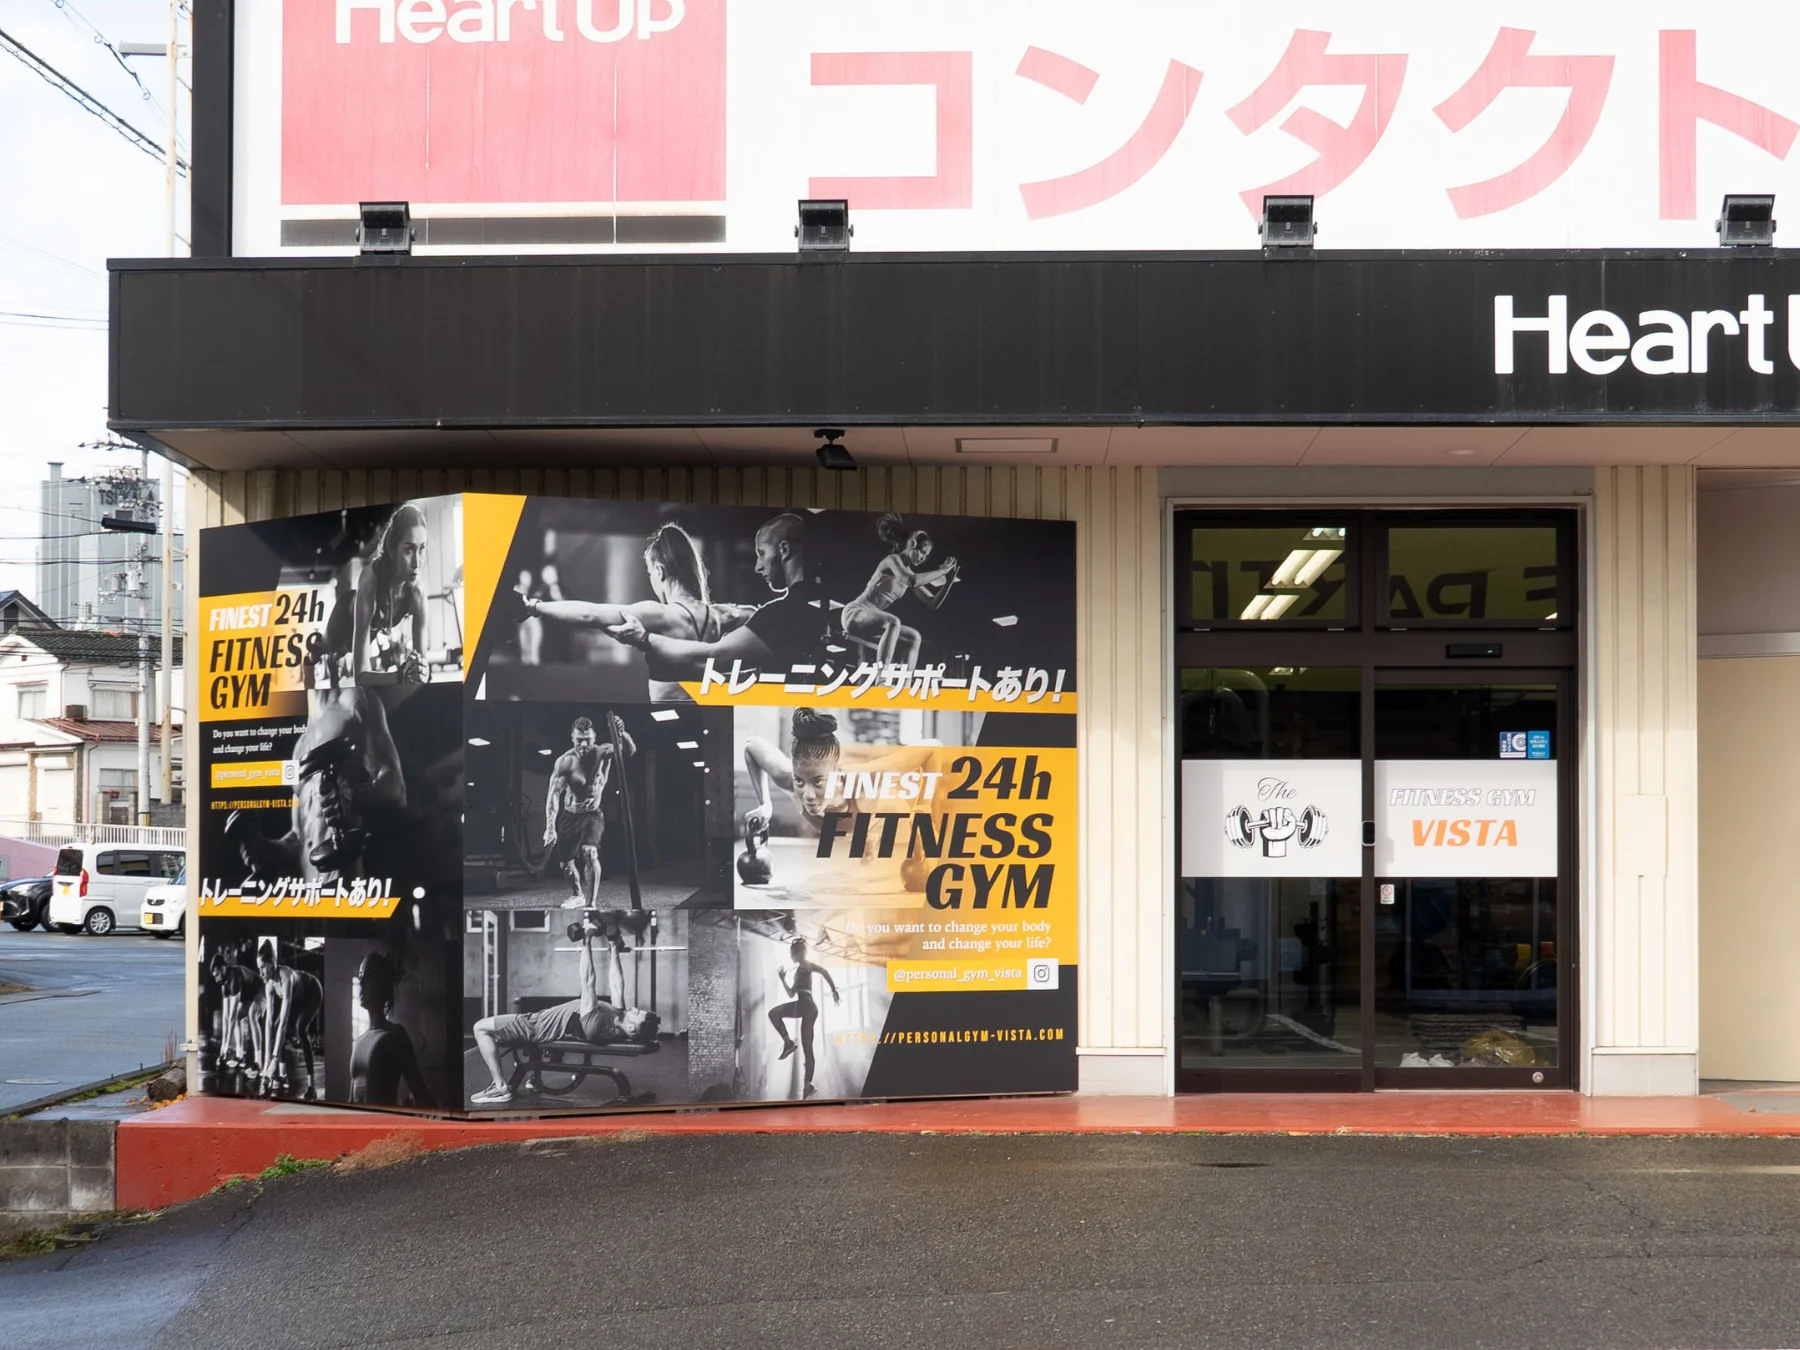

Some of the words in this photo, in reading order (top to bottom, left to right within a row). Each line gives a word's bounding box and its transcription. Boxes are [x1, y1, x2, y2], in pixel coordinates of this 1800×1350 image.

[808, 27, 1800, 221] コンタクト
[209, 603, 273, 632] FINEST
[274, 590, 325, 625] 24h
[209, 631, 324, 673] FITNESS
[210, 673, 272, 710] GYM
[212, 729, 222, 739] Do
[222, 730, 234, 740] you
[234, 729, 249, 737] want
[249, 729, 257, 737] to
[257, 726, 278, 738] change
[278, 727, 292, 737] your
[293, 724, 308, 735] body
[212, 744, 224, 754] and
[224, 744, 245, 755] change
[245, 744, 260, 755] your
[259, 742, 273, 752] life?
[823, 770, 944, 801] FINEST
[947, 755, 1053, 801] 24h
[1257, 776, 1297, 802] The
[1389, 788, 1483, 807] FITNESS
[1485, 788, 1537, 807] GYM
[816, 812, 1054, 859] FITNESS
[1411, 819, 1519, 847] VISTA
[925, 863, 1056, 910] GYM
[845, 922, 864, 933] Do
[867, 923, 890, 935] you
[894, 921, 925, 933] want
[928, 921, 942, 933] to
[944, 920, 988, 935] change
[989, 921, 1019, 935] your
[1022, 919, 1052, 934] body
[922, 938, 946, 950] and
[948, 937, 992, 952] change
[994, 939, 1024, 953] your
[1026, 936, 1052, 949] life?
[893, 966, 1023, 983] @personal_gym_vista
